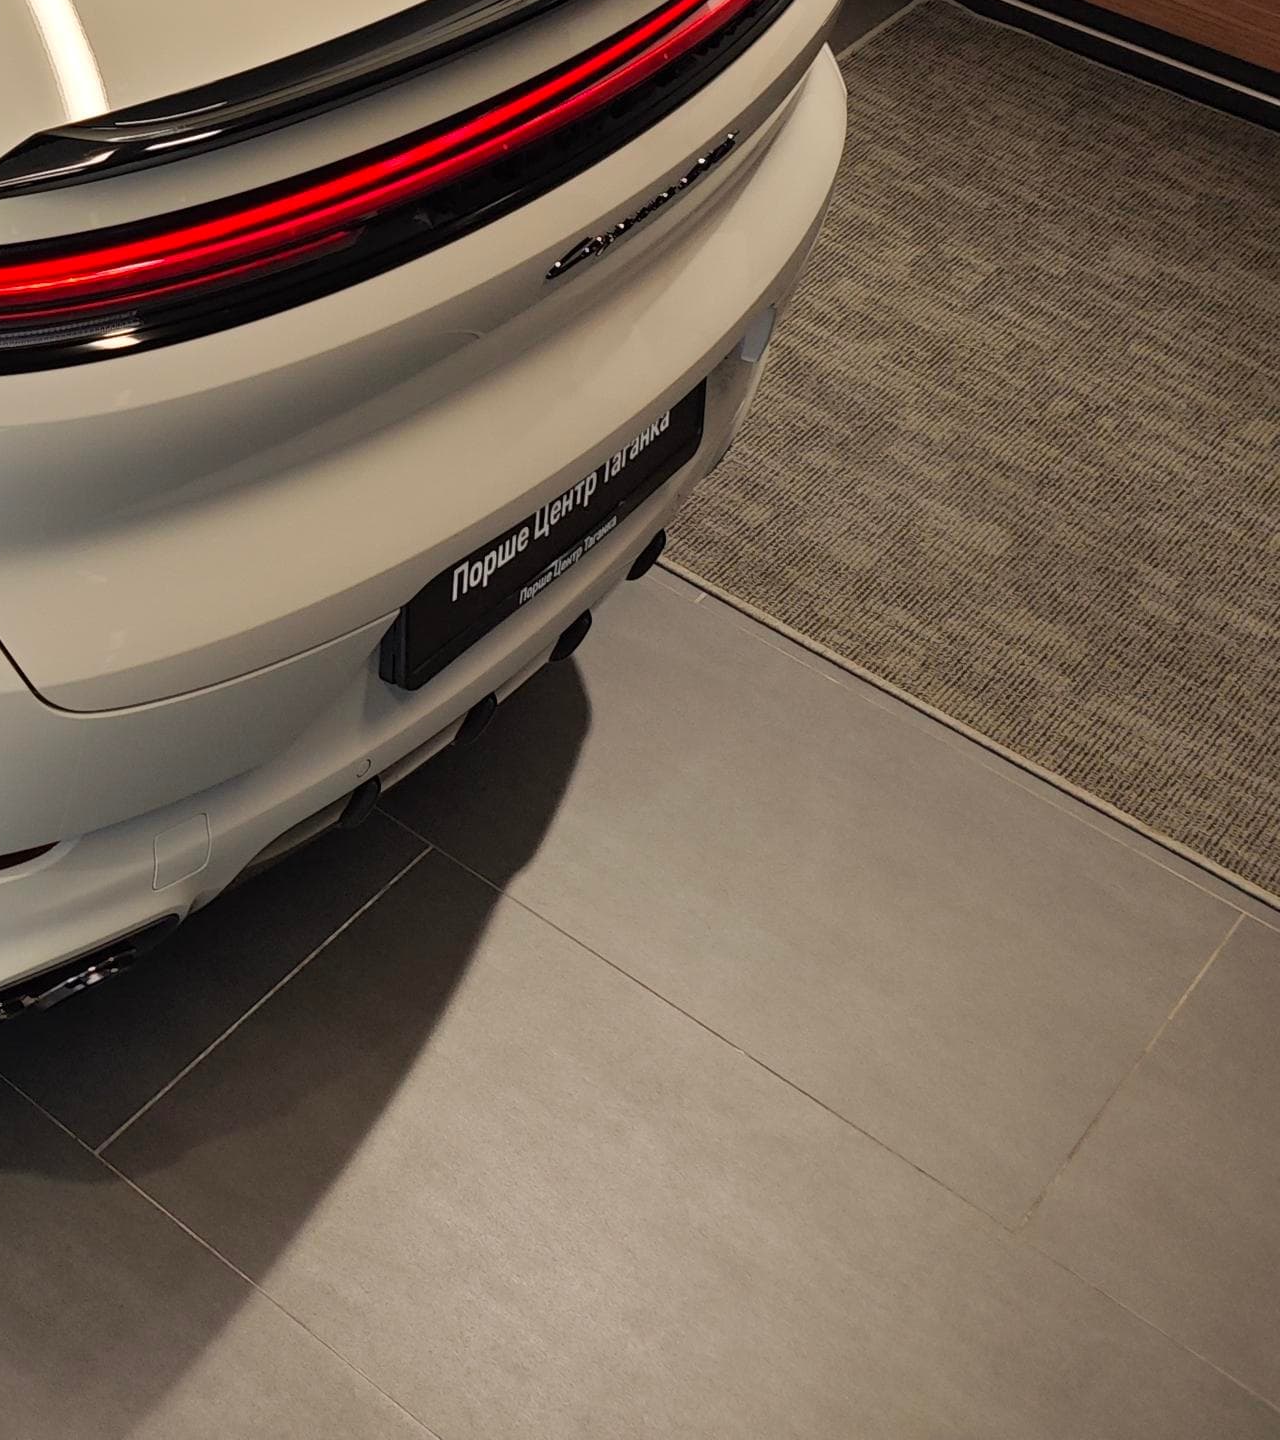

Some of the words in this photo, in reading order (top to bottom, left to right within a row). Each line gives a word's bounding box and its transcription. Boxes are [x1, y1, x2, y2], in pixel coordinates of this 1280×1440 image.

[452, 526, 530, 602] Порше
[534, 471, 598, 541] Центр
[519, 570, 553, 605] Порше
[552, 544, 583, 578] Центр
[583, 515, 618, 552] Таганка
